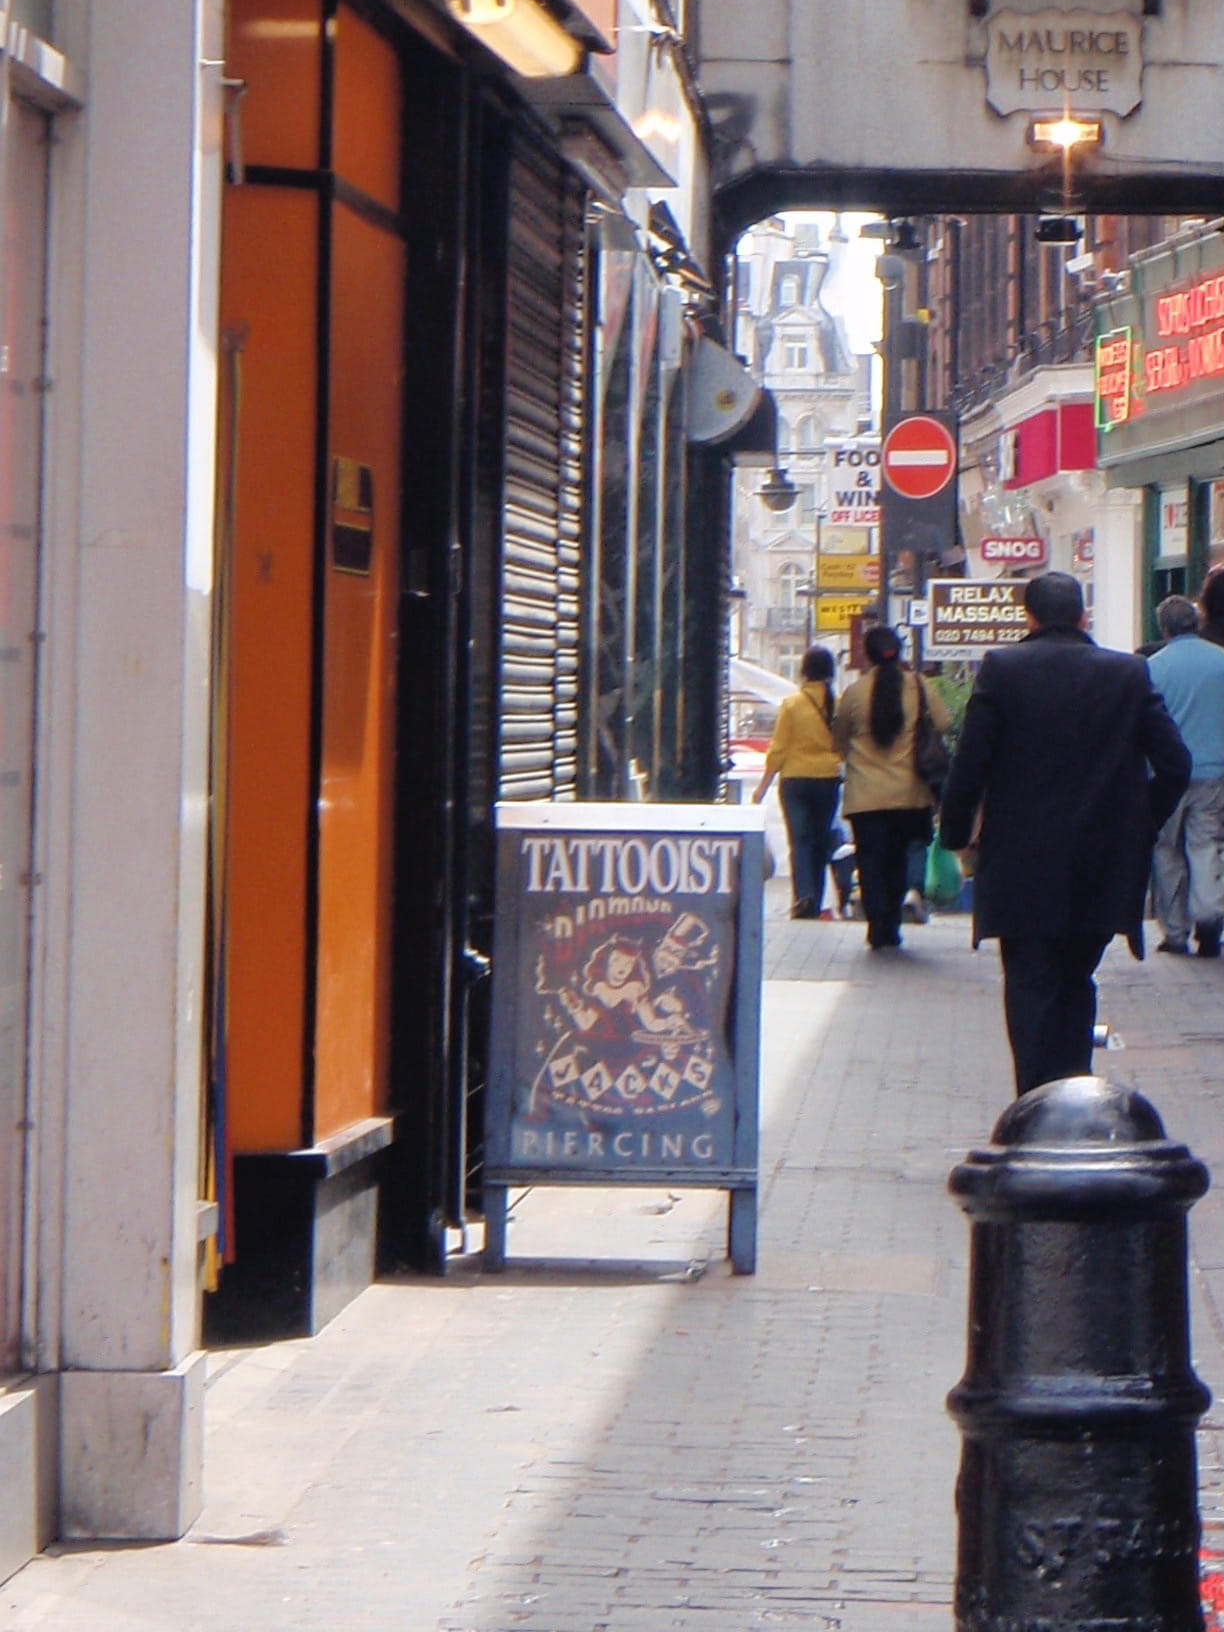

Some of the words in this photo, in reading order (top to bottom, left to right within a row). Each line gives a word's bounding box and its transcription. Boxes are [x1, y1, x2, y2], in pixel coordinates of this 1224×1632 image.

[999, 29, 1130, 56] MAURICE
[1018, 67, 1111, 93] HOUSE
[834, 450, 880, 468] FOO
[856, 471, 873, 488] &
[835, 490, 880, 507] WIN
[831, 510, 850, 523] OFF
[984, 540, 1039, 558] SNOG
[950, 587, 1014, 603] RELAX
[936, 606, 1028, 622] MASSAGE
[935, 629, 959, 643] 020
[521, 838, 741, 894] TATTOOIST
[521, 1131, 714, 1160] PIERCING
